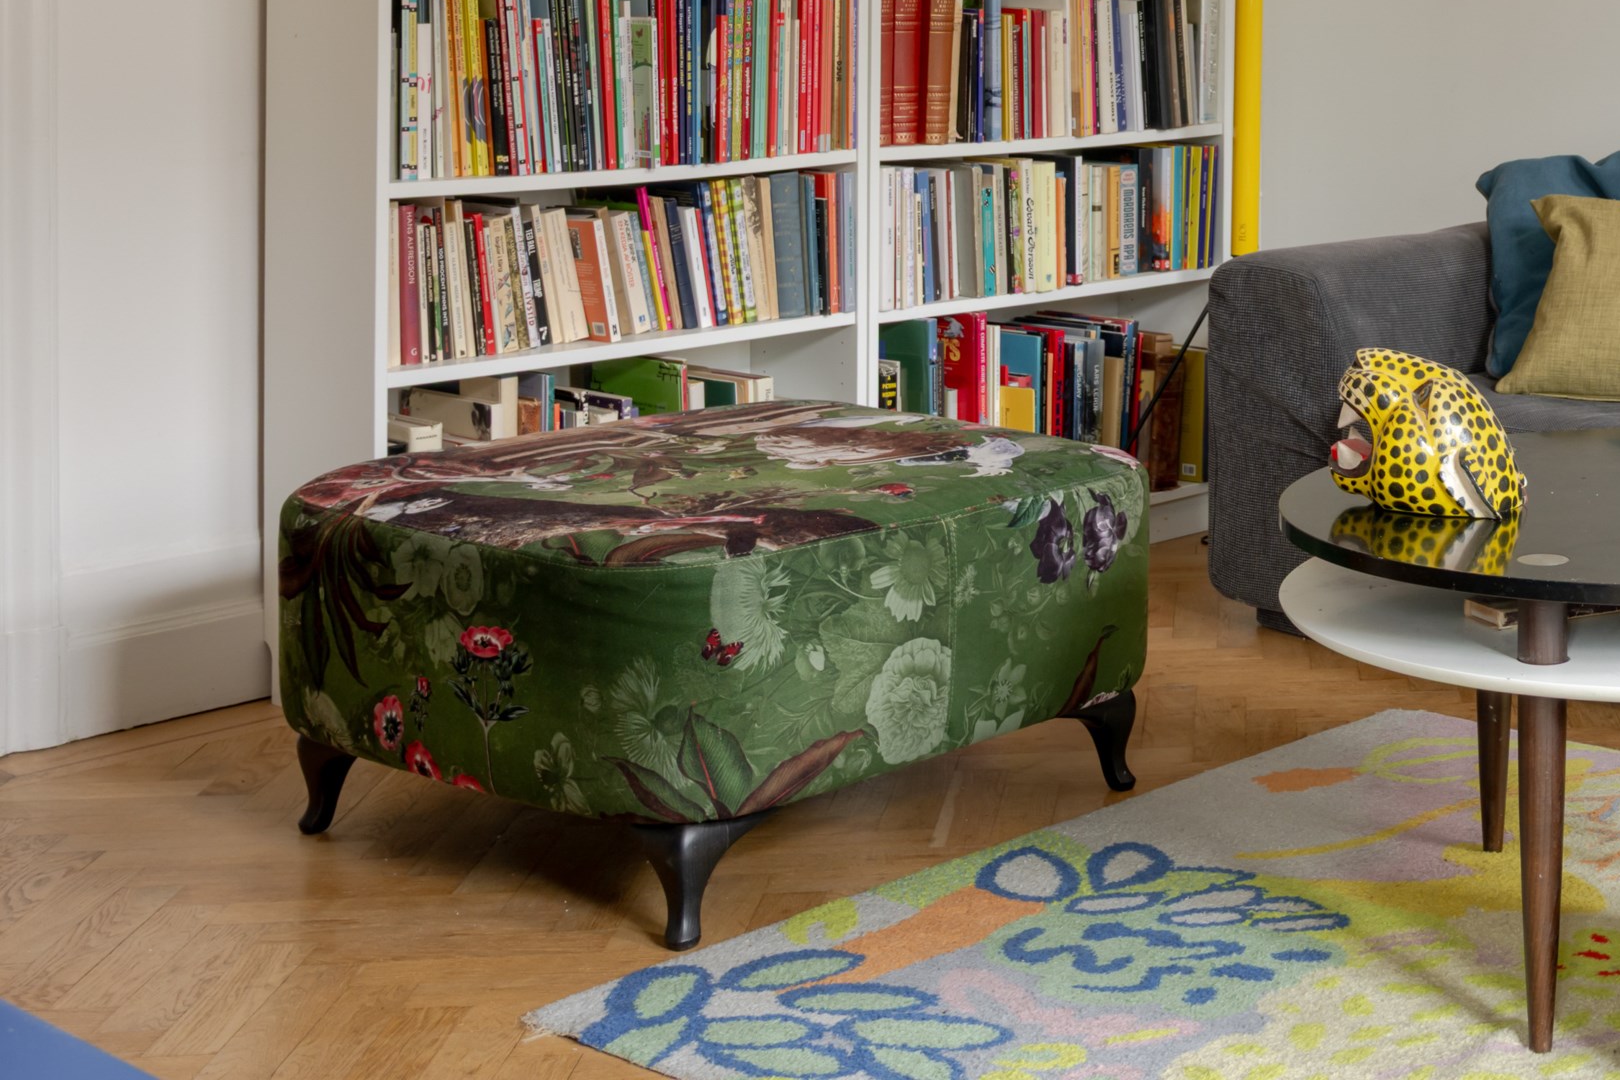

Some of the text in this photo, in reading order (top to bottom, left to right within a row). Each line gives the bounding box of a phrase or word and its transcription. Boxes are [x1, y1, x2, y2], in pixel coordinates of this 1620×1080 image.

[619, 232, 628, 252] KEDJA
[1123, 244, 1133, 260] APA
[407, 237, 415, 284] ALFREDSON
[525, 229, 542, 298] TED RALL TRUMP
